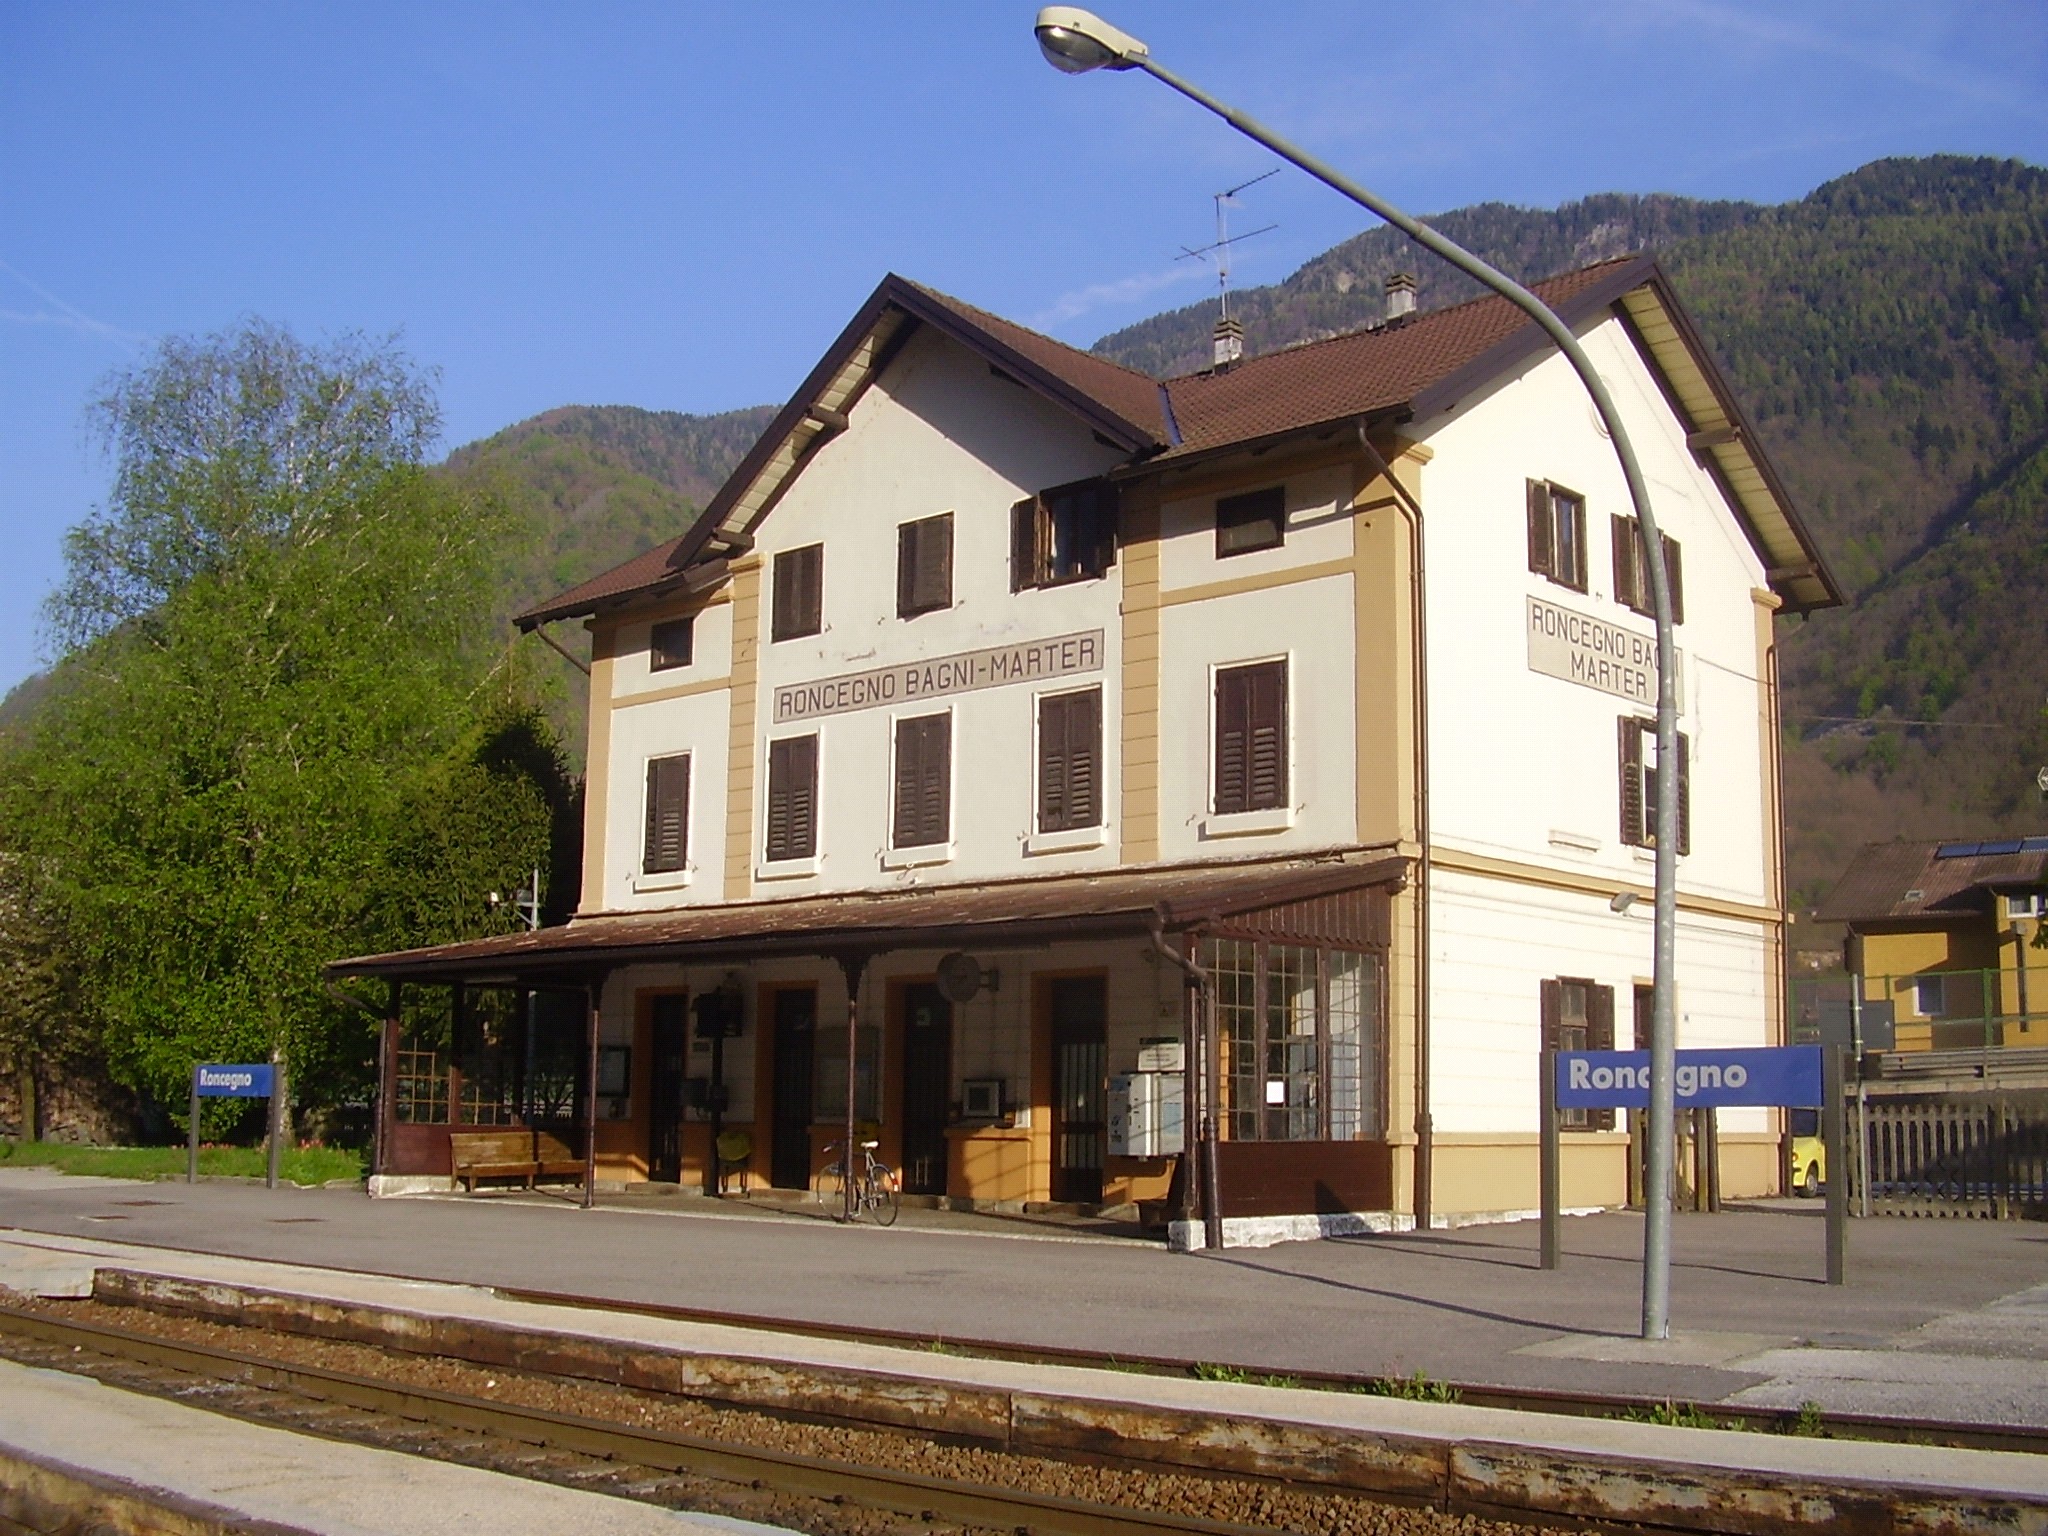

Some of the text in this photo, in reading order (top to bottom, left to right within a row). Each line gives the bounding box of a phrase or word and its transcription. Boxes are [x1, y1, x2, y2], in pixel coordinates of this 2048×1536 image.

[1532, 604, 1625, 659] RONCEGNO
[780, 638, 1096, 717] RONCEGNO BAGNI-MARTER
[1571, 650, 1647, 699] MARTER
[200, 1068, 252, 1090] Roncegno
[1569, 1058, 1747, 1097] Roncgno
